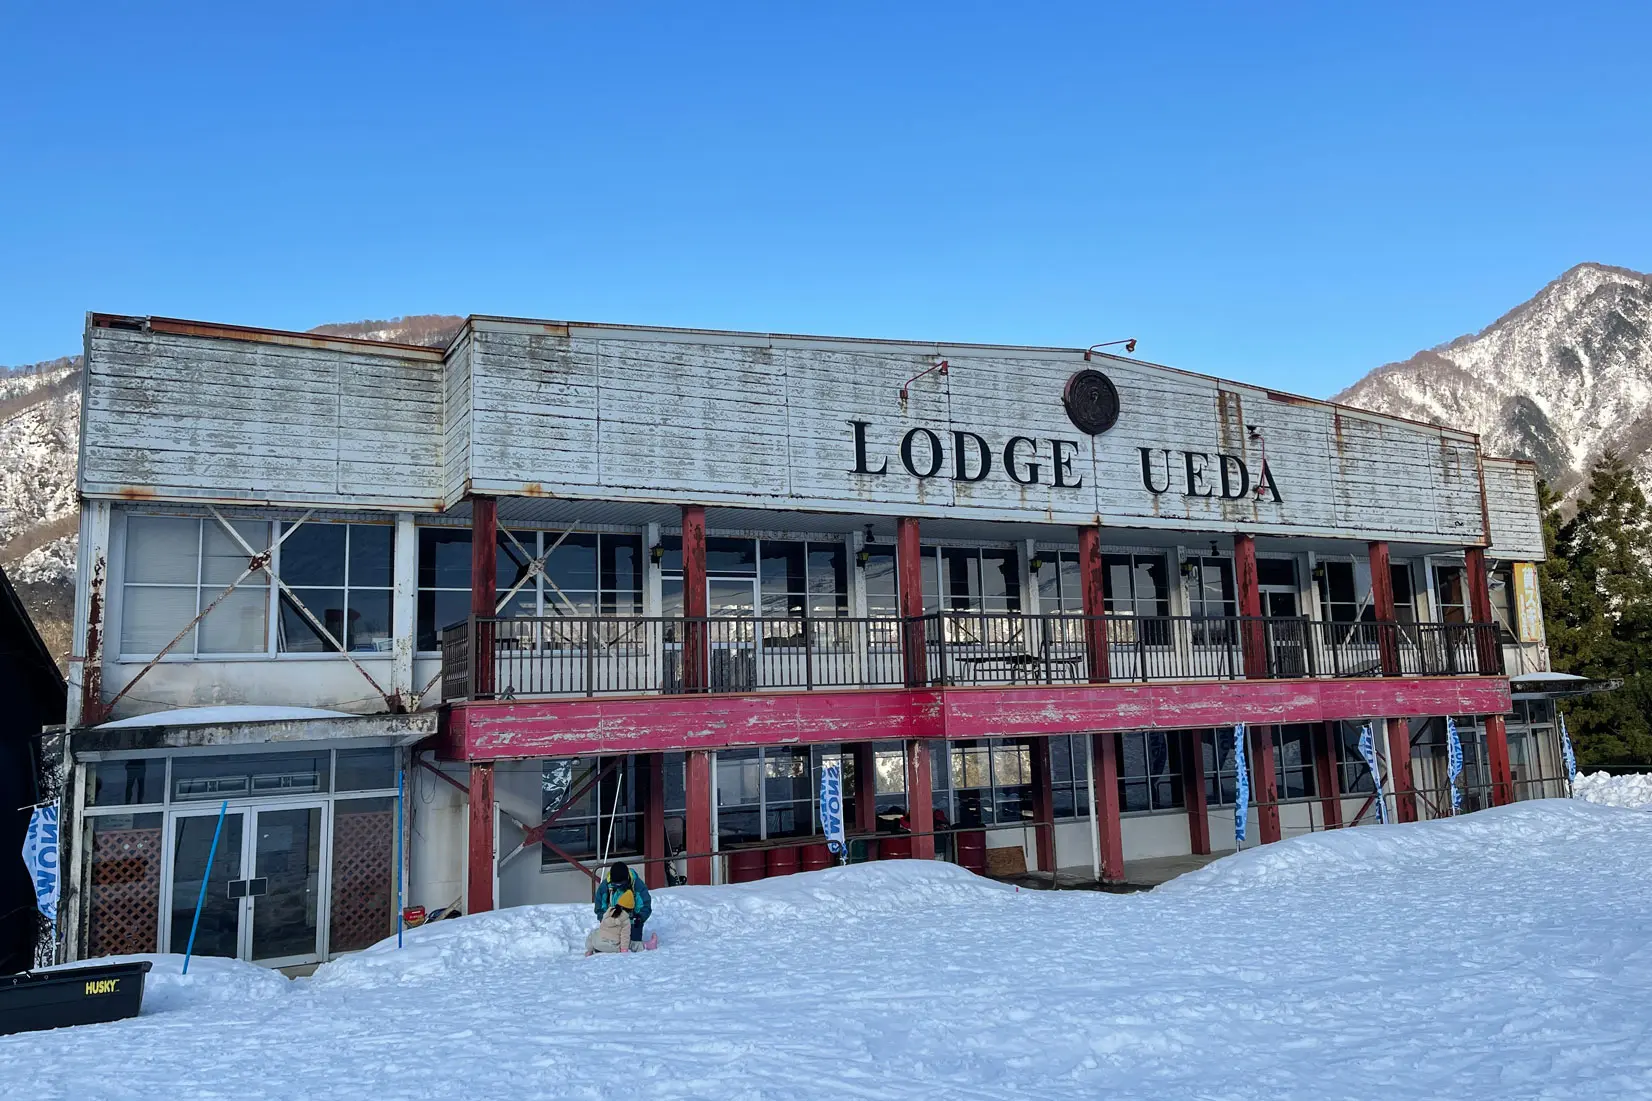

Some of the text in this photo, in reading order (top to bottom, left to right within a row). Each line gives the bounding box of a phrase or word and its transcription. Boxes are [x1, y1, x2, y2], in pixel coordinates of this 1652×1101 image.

[846, 419, 1284, 504] LODGE UEDA
[85, 979, 117, 995] HUSKY
